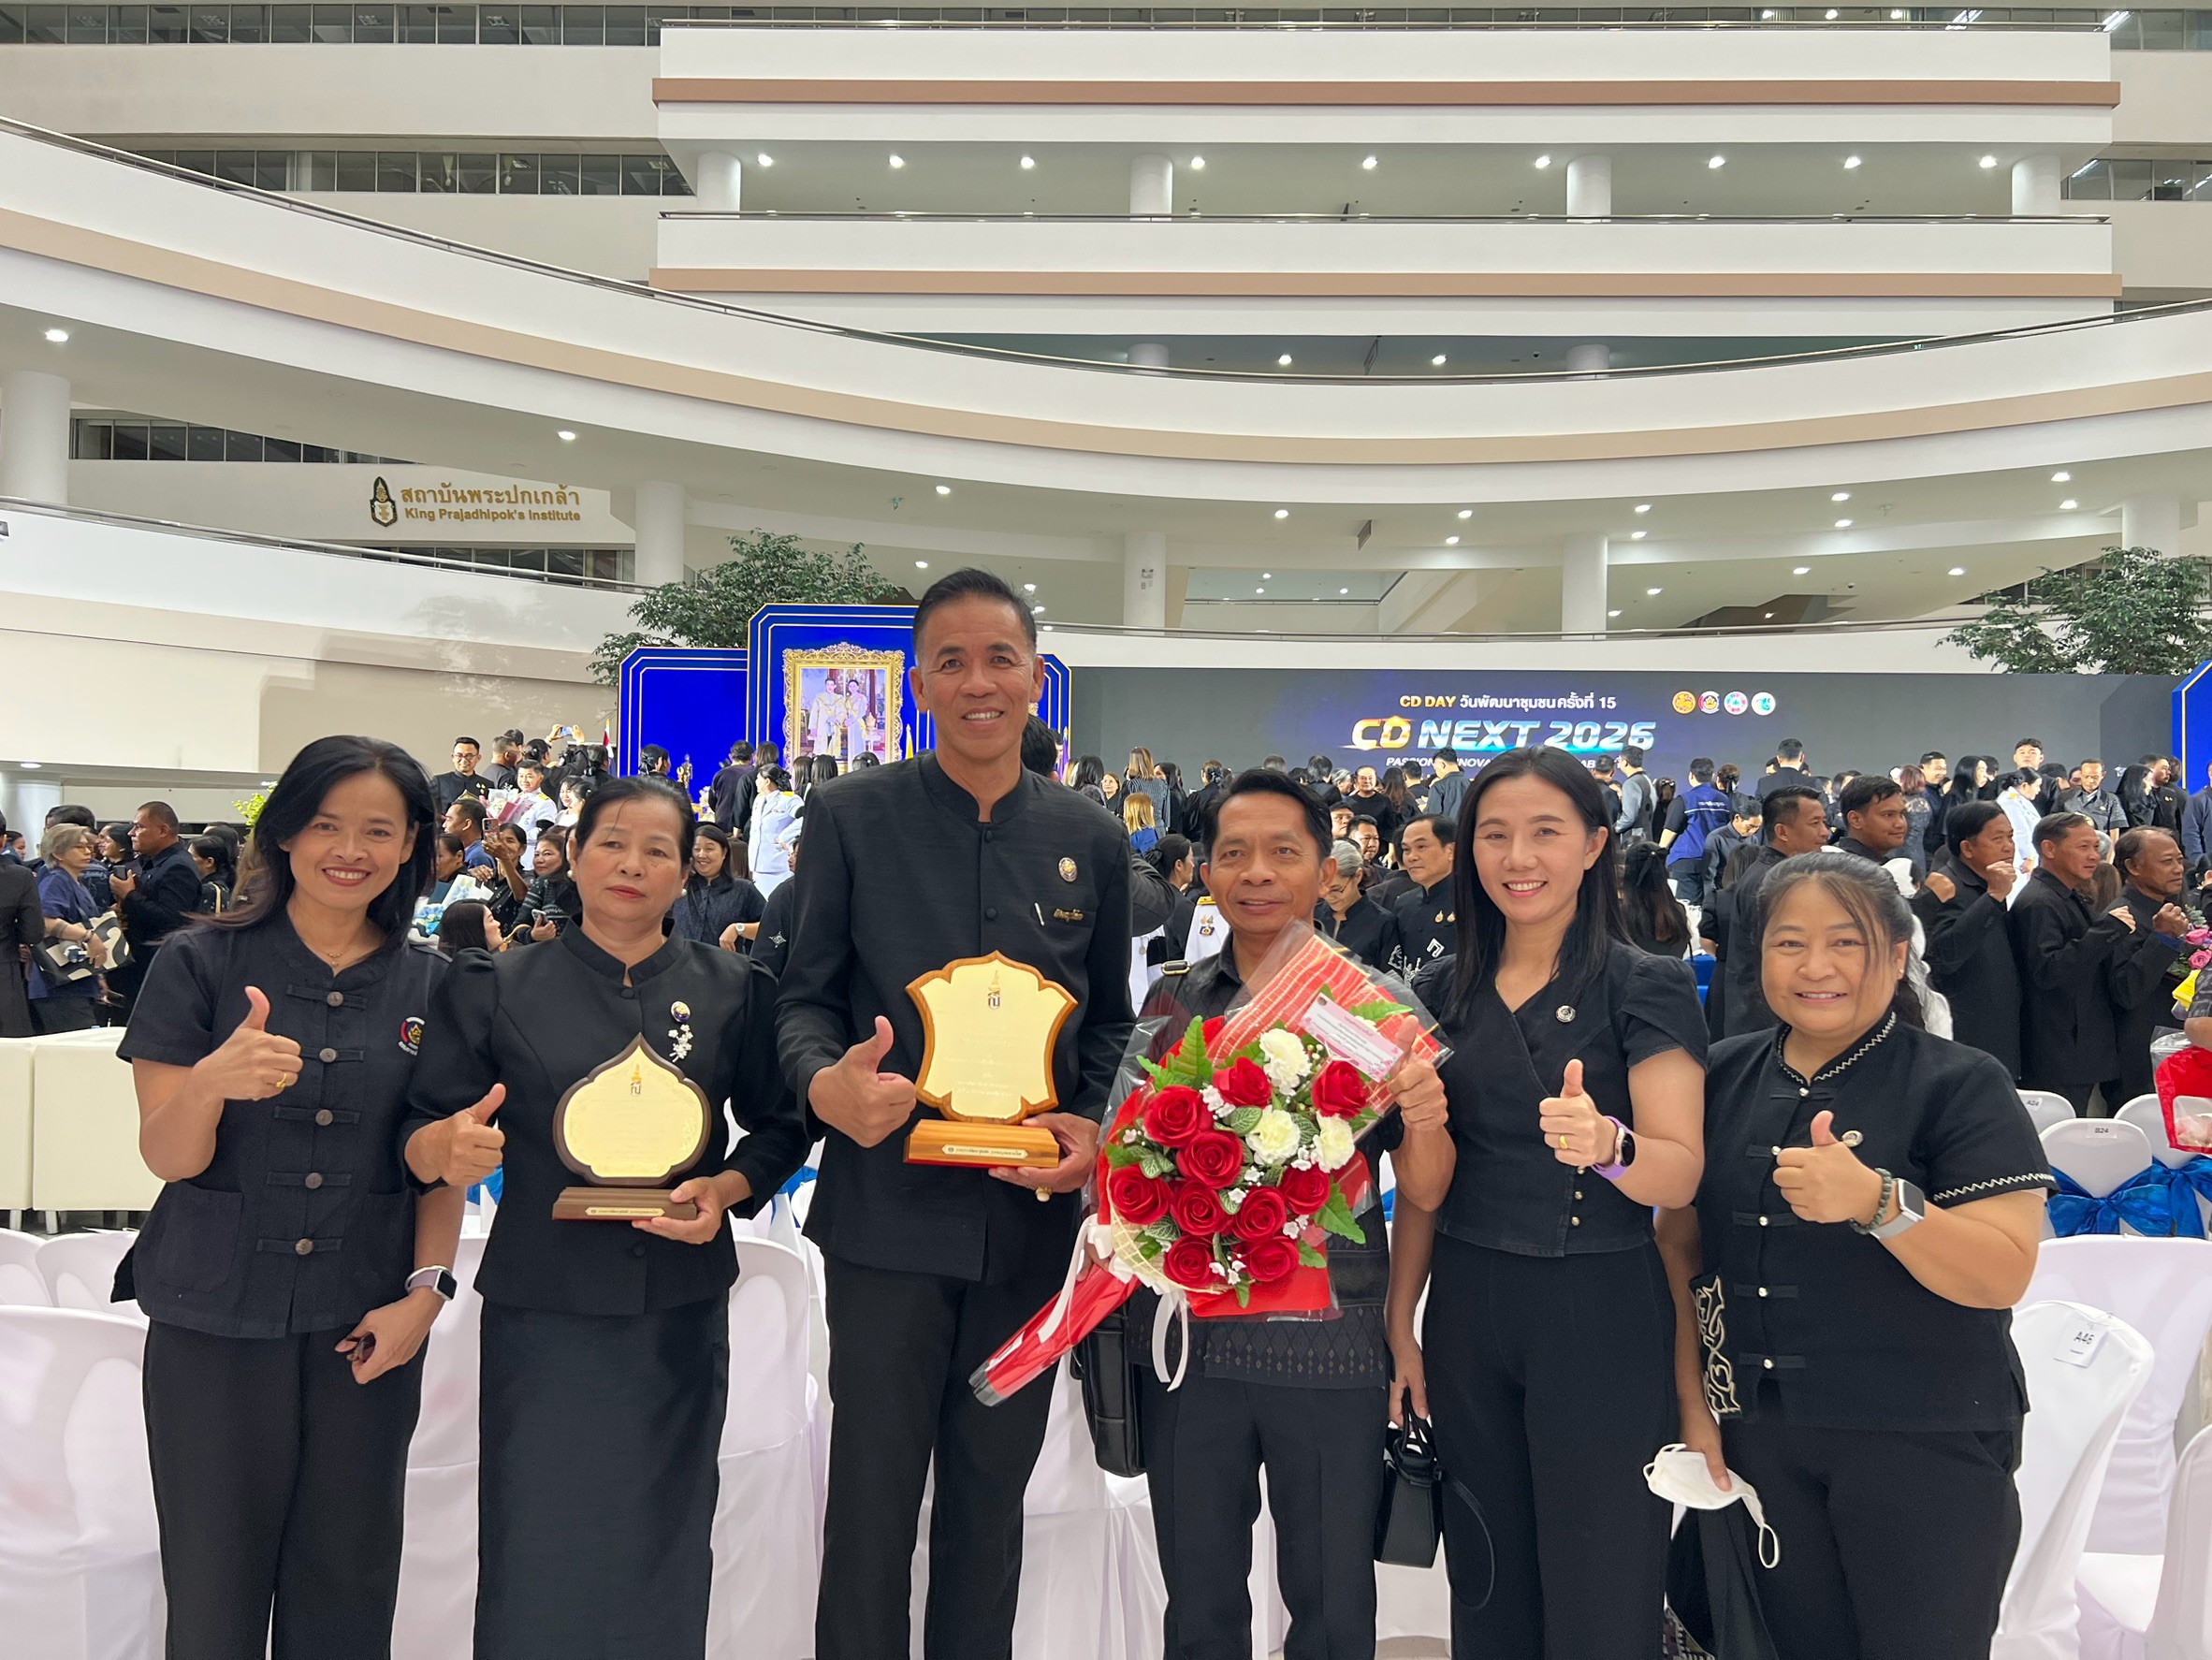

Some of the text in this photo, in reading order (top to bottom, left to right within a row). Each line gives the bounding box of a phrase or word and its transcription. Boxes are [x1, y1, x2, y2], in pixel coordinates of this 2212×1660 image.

[400, 481, 580, 505] สถาบันพระปกเกล้า
[404, 507, 581, 522] King Prajadhipok's Institute
[1399, 692, 1617, 713] CD DAY วันพัฒนาชุมชน ครั้งที่ 15
[1351, 717, 1657, 751] CD NEXT 2026
